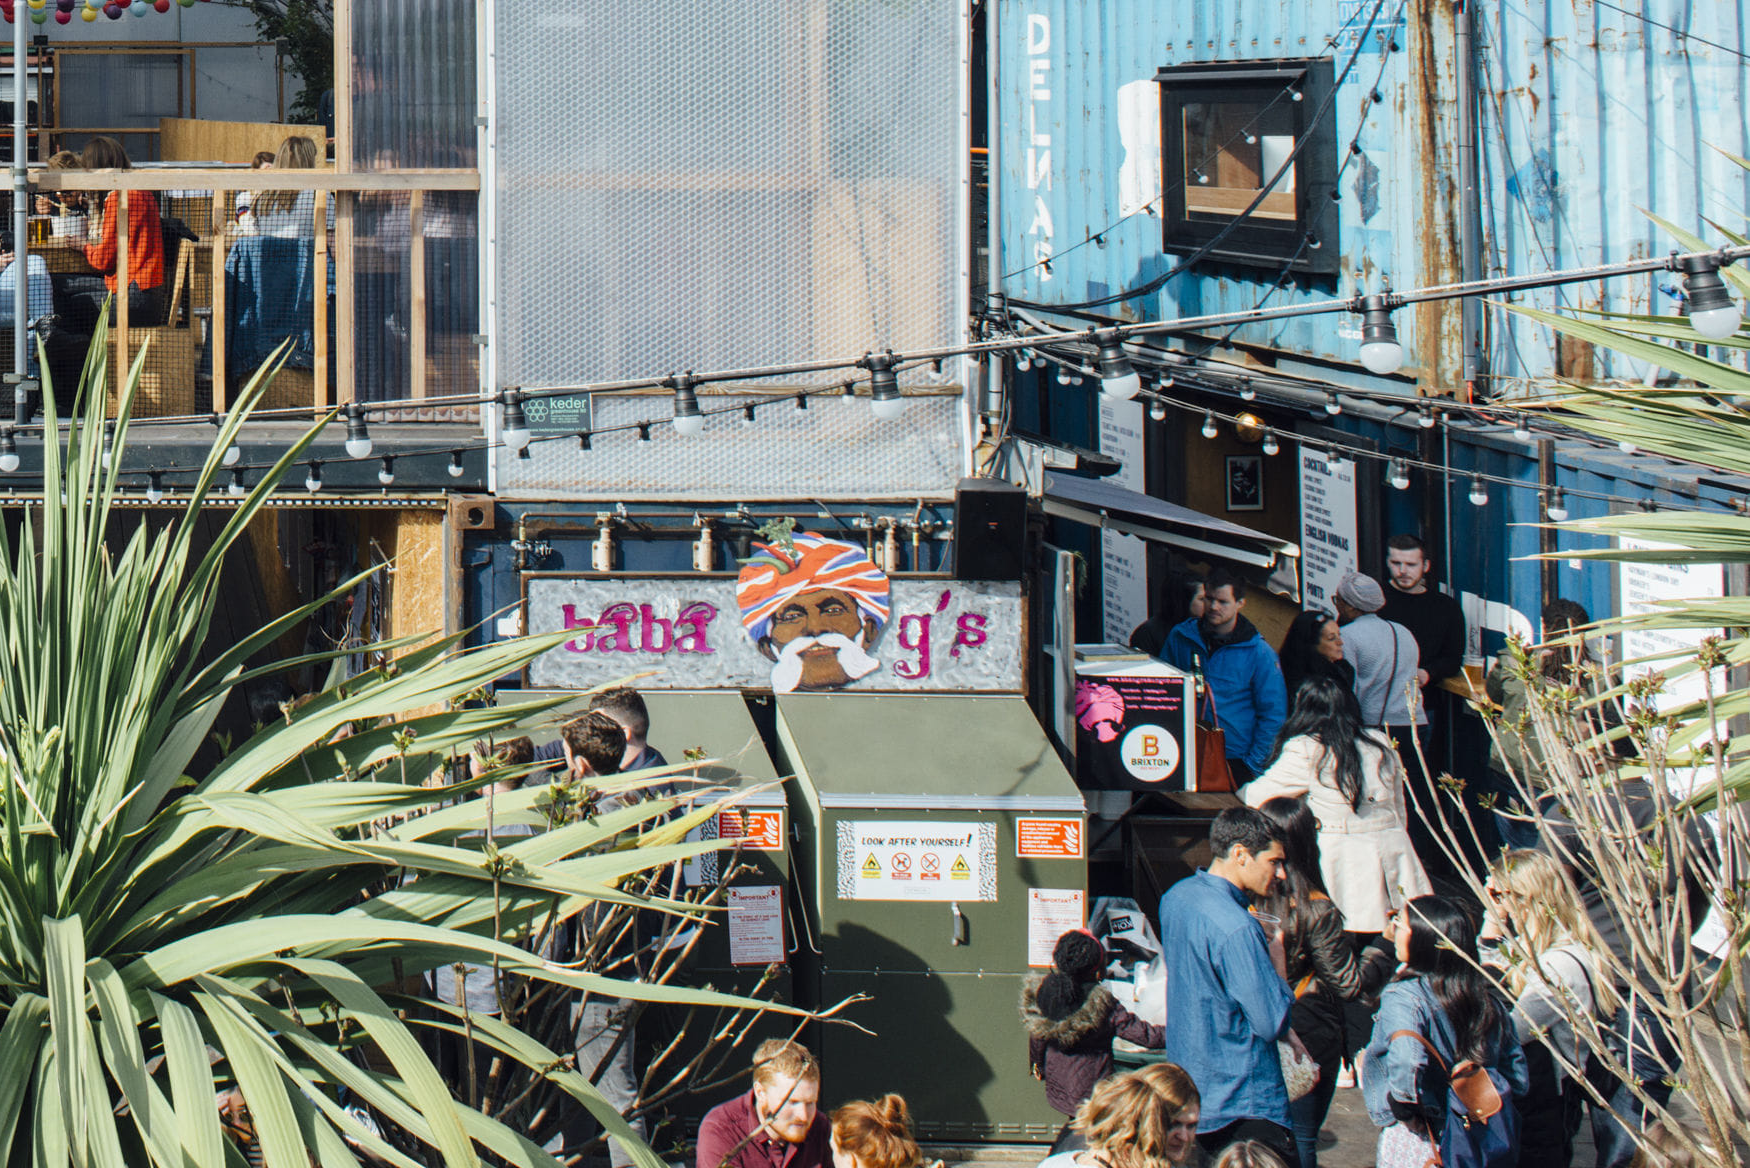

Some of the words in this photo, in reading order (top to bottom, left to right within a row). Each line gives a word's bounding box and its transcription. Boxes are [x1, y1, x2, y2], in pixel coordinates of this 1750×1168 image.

[550, 397, 587, 409] keder
[561, 601, 718, 654] baba
[1131, 758, 1170, 766] BRIXTON
[861, 837, 885, 846] LOOK
[887, 837, 917, 846] AFTER
[919, 833, 973, 848] YOURSELF!
